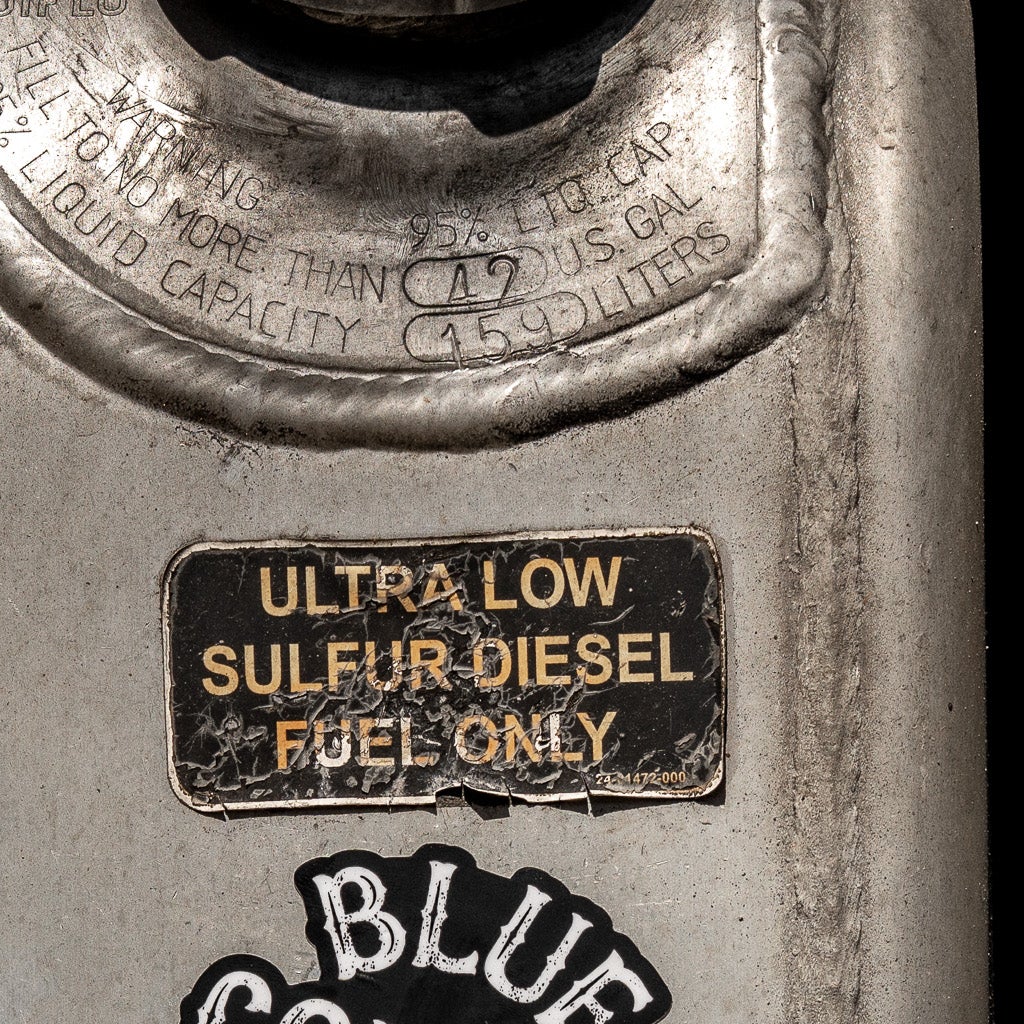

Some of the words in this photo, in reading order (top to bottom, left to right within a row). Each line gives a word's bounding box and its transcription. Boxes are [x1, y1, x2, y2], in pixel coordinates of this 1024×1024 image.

[6, 40, 70, 120] FILL
[63, 112, 110, 161] TO
[102, 157, 159, 208] NO
[159, 198, 266, 273] MORE
[284, 249, 387, 304] THAN
[106, 79, 264, 211] WARNING
[410, 207, 488, 251] 95%
[513, 178, 594, 233] LIQ
[607, 121, 672, 186] CAP
[20, 150, 148, 267] LIQUID
[160, 260, 361, 353] CAPACITY
[440, 306, 554, 369] 159
[592, 221, 731, 320] LITERS
[447, 254, 525, 308] 42
[552, 227, 615, 276] US
[625, 183, 702, 240] GAL
[260, 562, 464, 616] ULTRA
[483, 556, 622, 609] LOW
[201, 639, 454, 696] SULFUR
[475, 632, 694, 687] DIESEL
[277, 717, 434, 770] FUEL
[455, 711, 616, 763] ONLY
[595, 771, 686, 785] 24-1472-000
